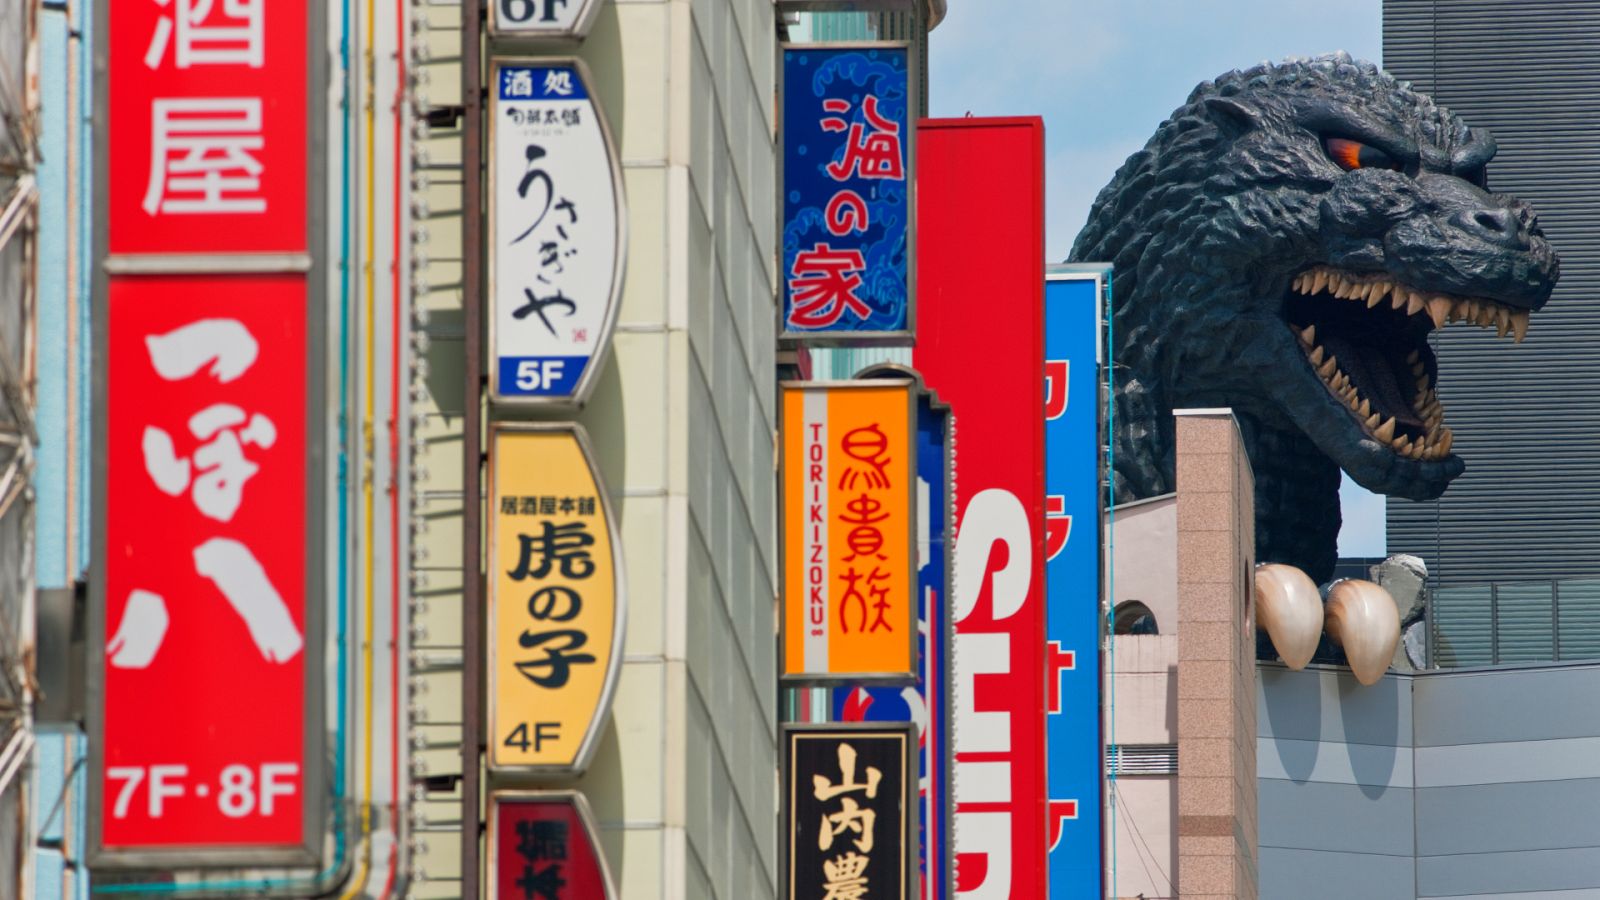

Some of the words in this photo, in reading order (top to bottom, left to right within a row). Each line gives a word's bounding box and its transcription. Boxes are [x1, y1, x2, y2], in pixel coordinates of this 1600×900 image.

[504, 69, 574, 97] 酒処
[509, 144, 578, 339] うさぎや
[788, 94, 905, 327] 海の家
[515, 360, 565, 390] 5F
[106, 317, 304, 668] つぼ八
[501, 496, 596, 516] 居酒屋本舗
[838, 422, 893, 635] 鳥貴族
[506, 520, 596, 690] 虎の子
[503, 722, 562, 752] 4F
